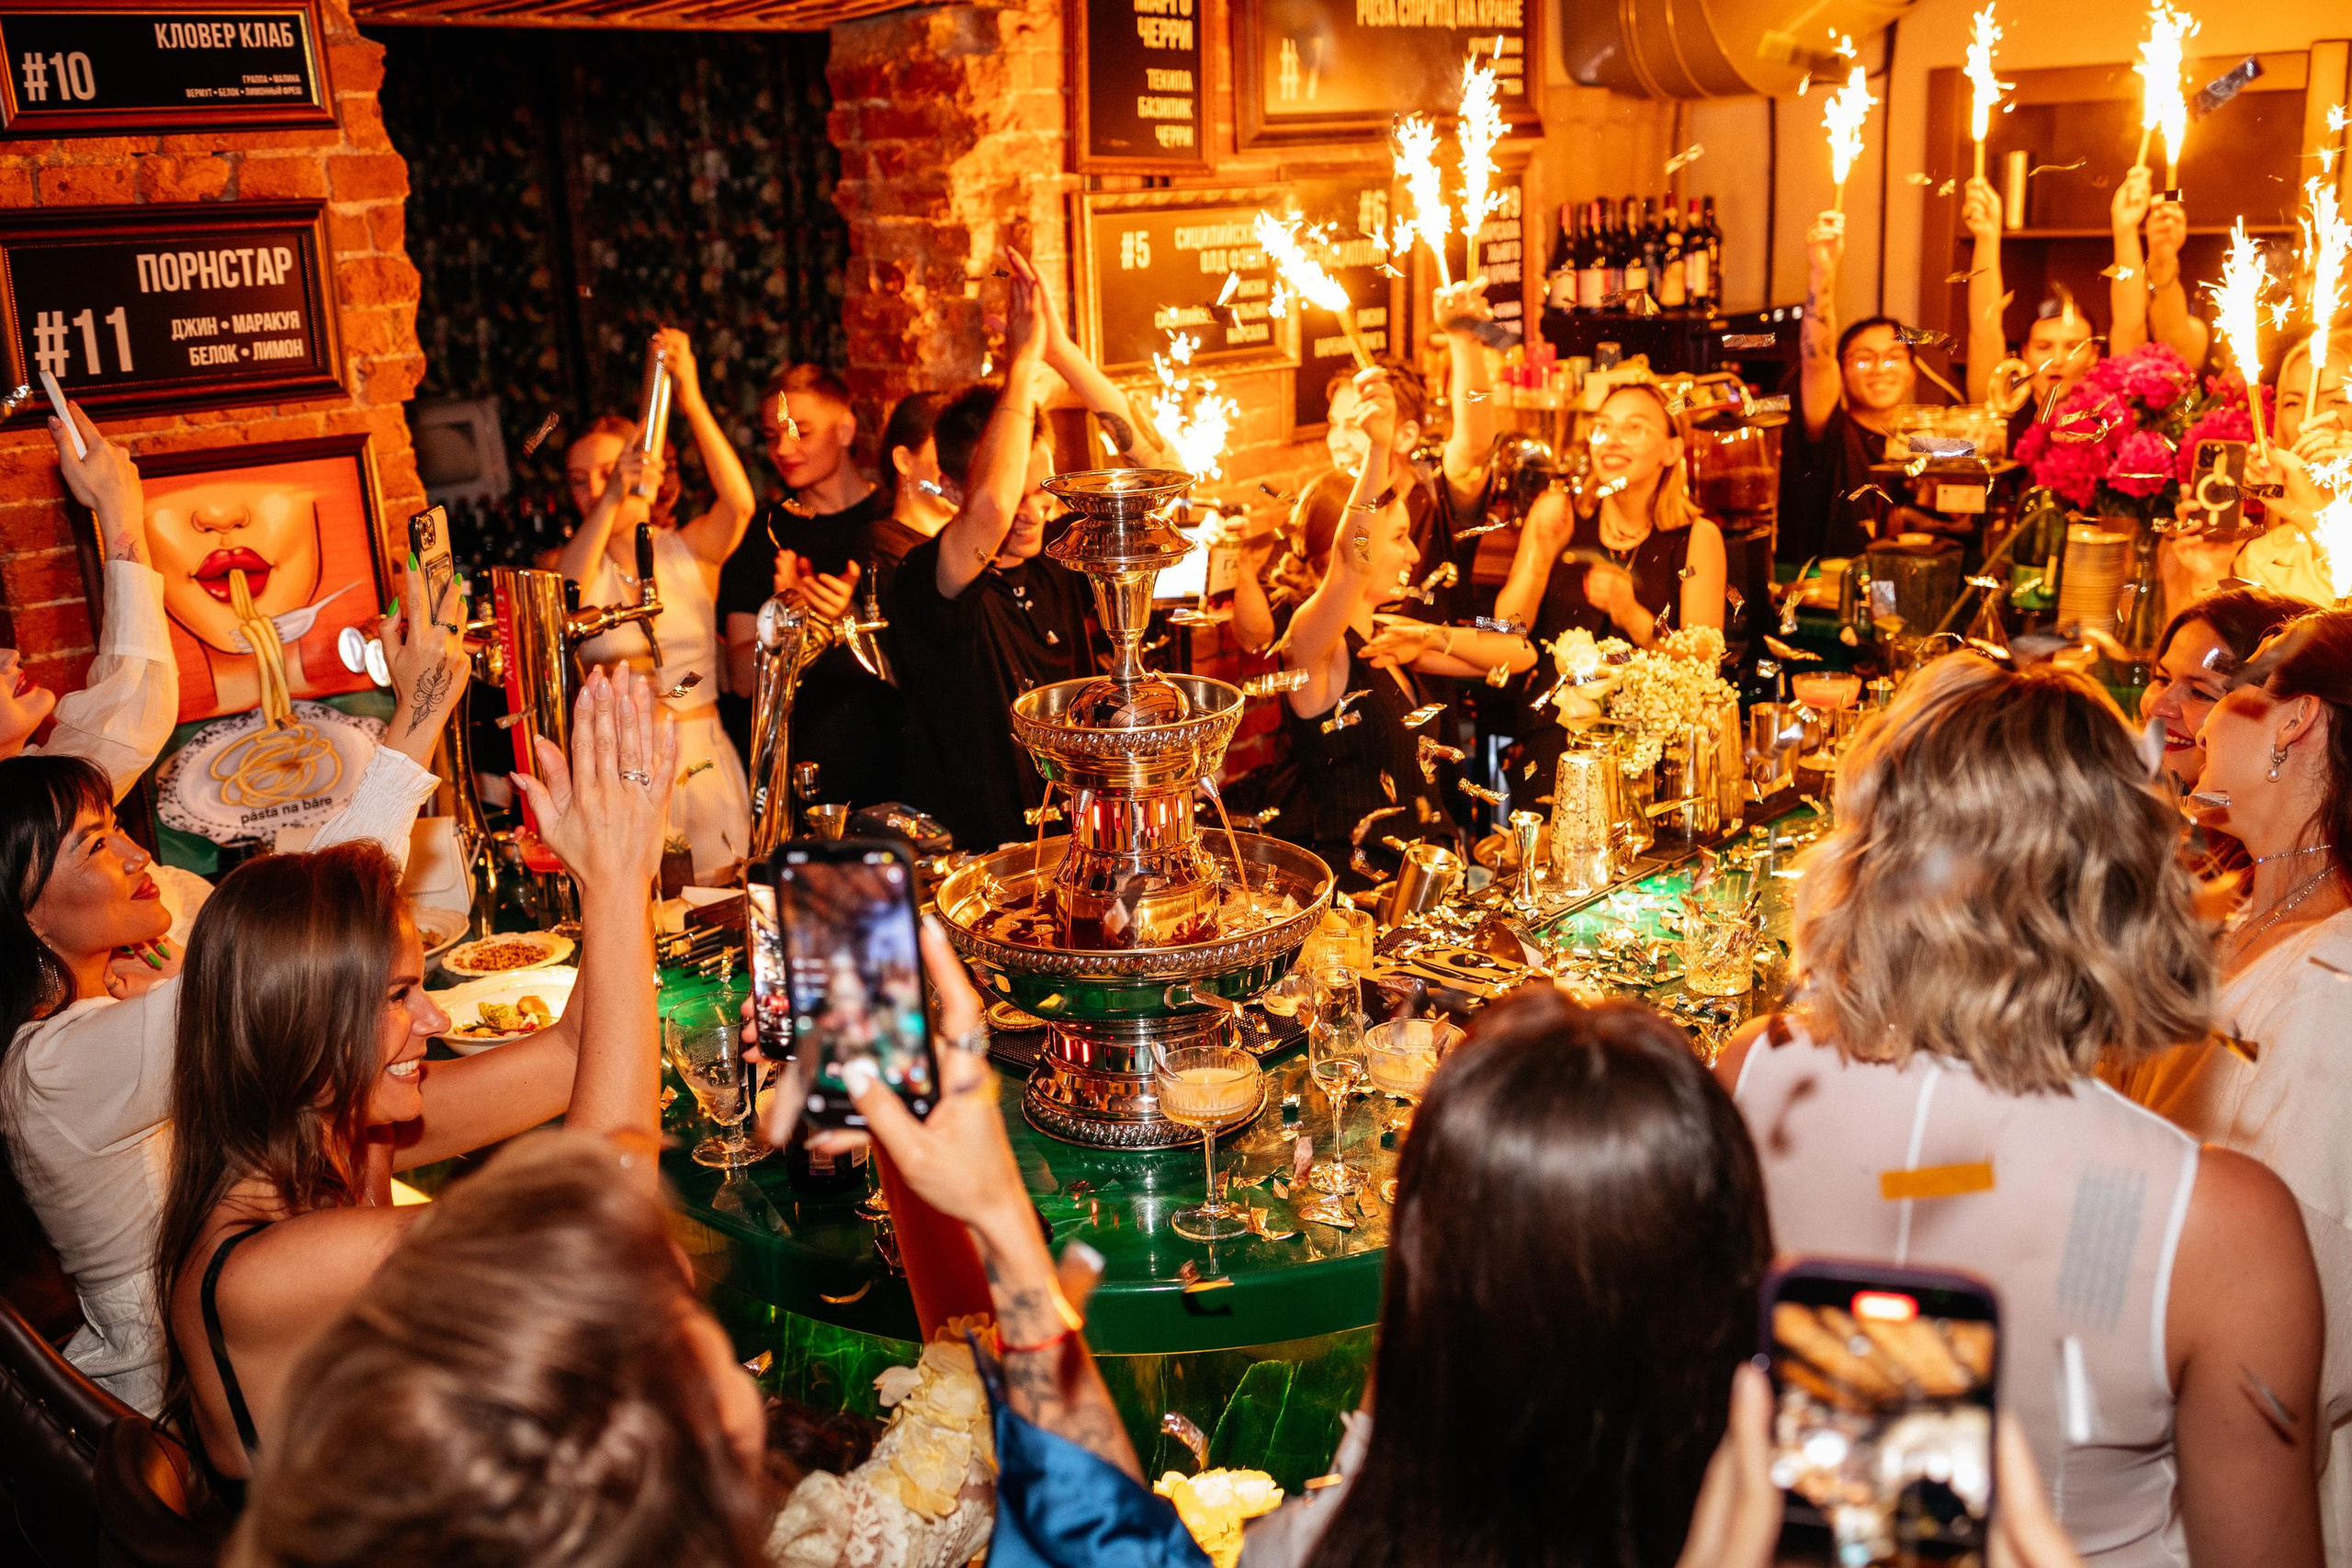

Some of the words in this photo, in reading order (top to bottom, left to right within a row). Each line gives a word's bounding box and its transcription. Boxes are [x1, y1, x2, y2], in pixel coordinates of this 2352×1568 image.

[154, 23, 236, 49] КЛОВЕР
[239, 22, 295, 48] КЛАБ
[1137, 17, 1193, 51] ЧЕРРИ
[22, 51, 96, 102] #10
[186, 88, 213, 98] ВЕРМУТ
[218, 87, 240, 97] БЕЛОК
[1137, 96, 1193, 120] БАЗИЛИК
[1120, 230, 1151, 270] #5
[136, 246, 293, 293] ПОРНСТАР
[171, 316, 219, 341] ДЖИН
[232, 310, 301, 334] МАРАКУЯ
[34, 306, 134, 378] #11
[188, 344, 240, 367] БЕЛОК
[253, 339, 304, 361] ЛИМОН
[498, 616, 514, 682] AMSTEL
[282, 803, 300, 815] na
